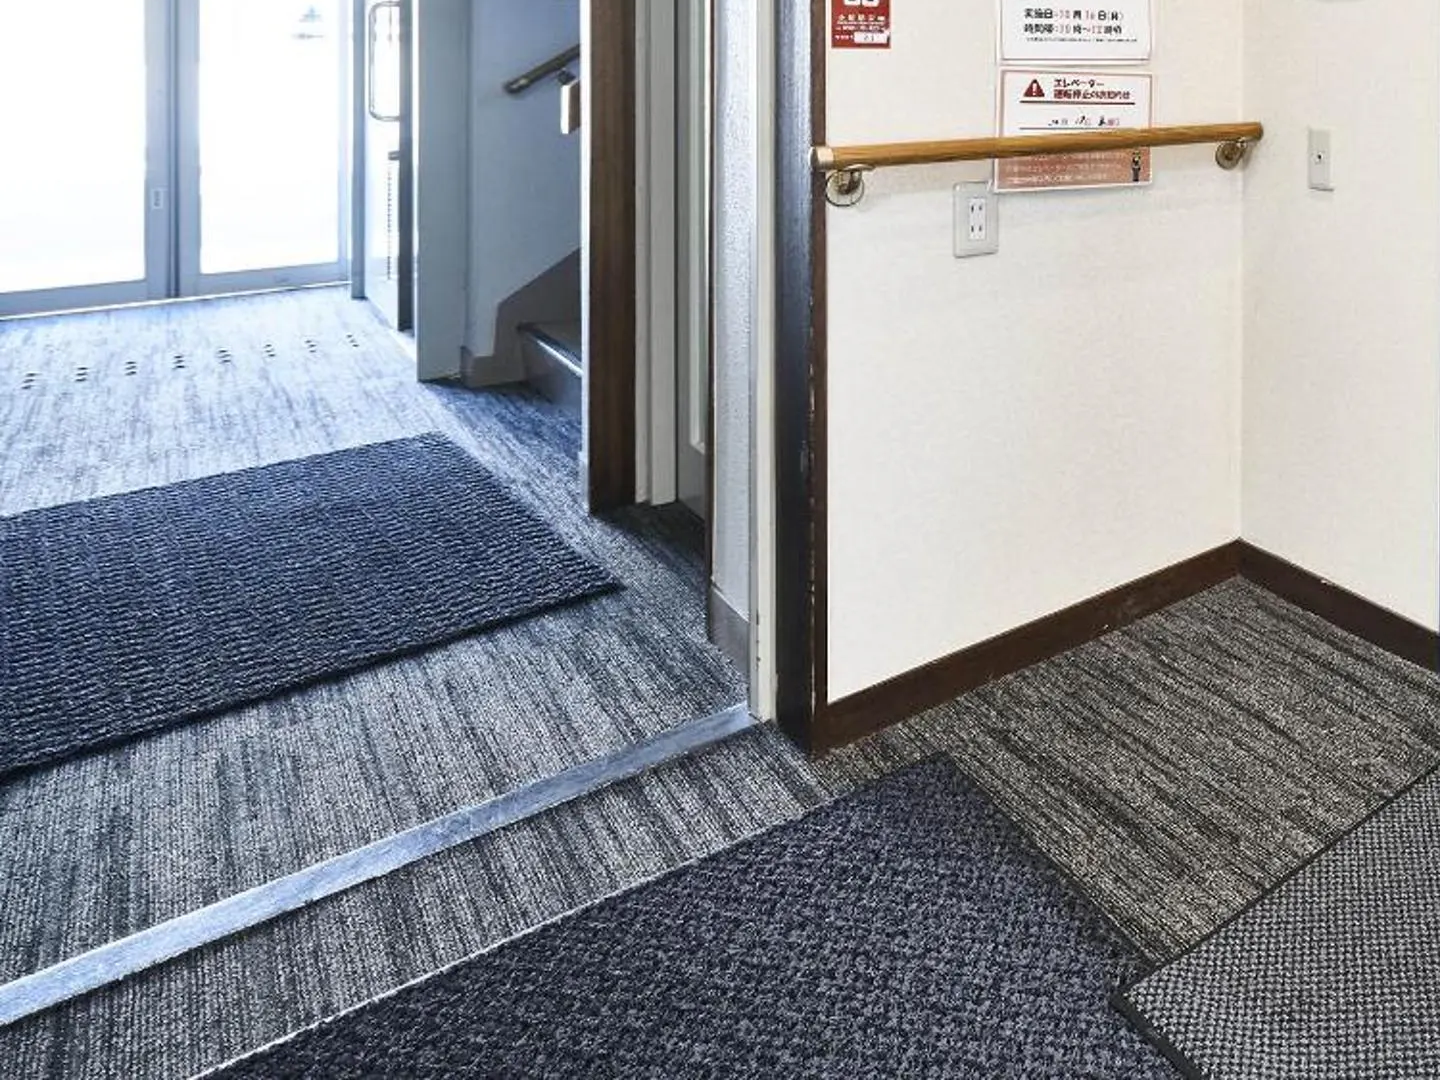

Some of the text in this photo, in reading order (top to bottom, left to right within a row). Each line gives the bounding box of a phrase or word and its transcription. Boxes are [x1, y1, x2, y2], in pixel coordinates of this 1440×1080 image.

[1054, 79, 1104, 89] エレベーター
